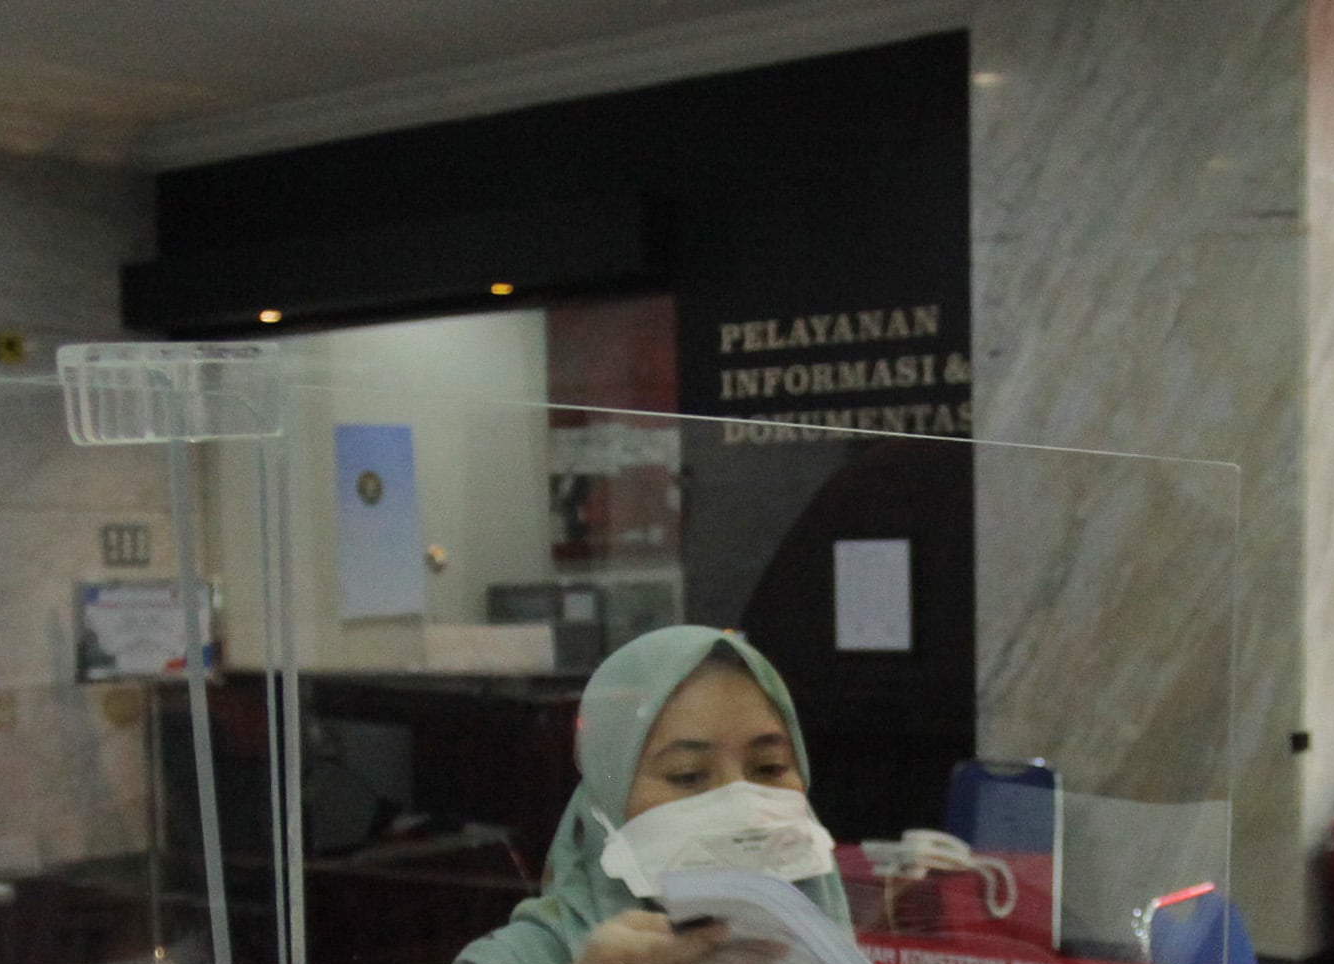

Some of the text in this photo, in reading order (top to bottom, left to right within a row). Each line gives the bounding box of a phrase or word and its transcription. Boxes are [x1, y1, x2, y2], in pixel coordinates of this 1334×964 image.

[719, 304, 940, 354] PELAYANAN
[720, 353, 971, 401] INFORMASI &
